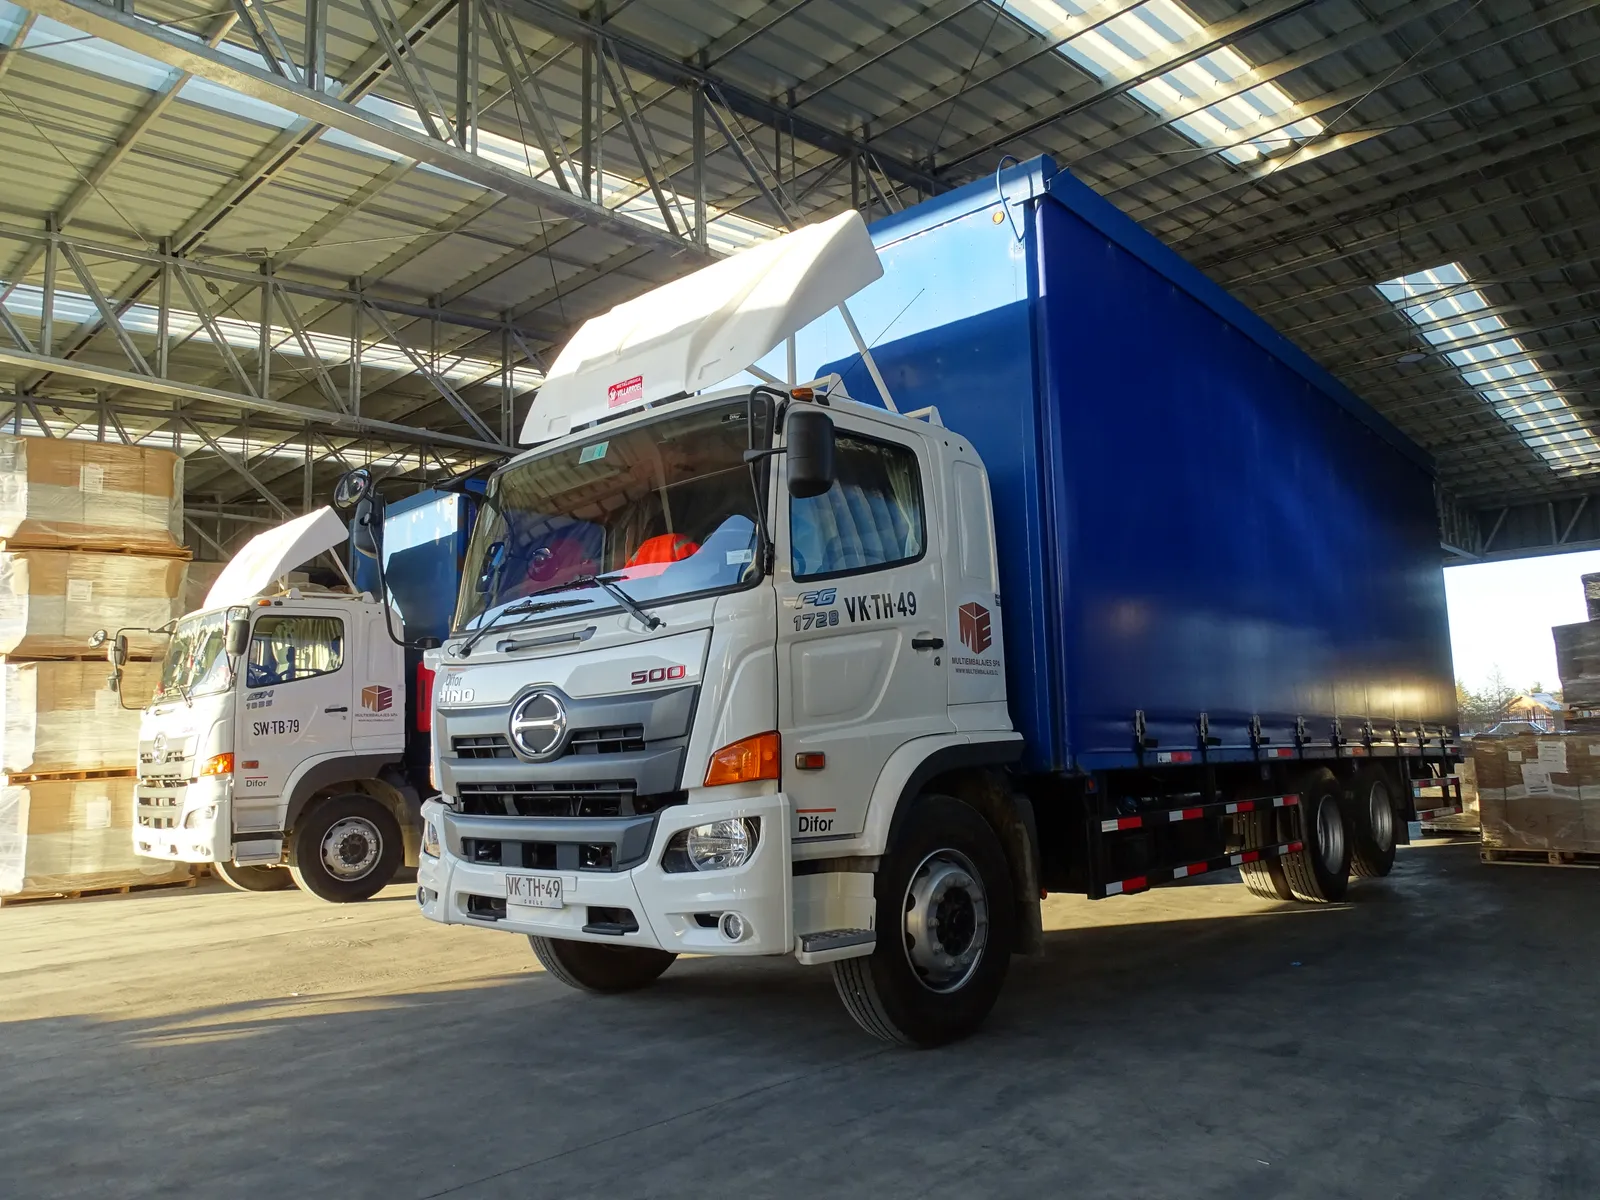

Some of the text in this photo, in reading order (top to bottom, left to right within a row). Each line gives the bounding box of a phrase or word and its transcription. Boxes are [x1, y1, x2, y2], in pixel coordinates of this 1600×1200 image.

[794, 588, 837, 609] FG
[793, 610, 839, 631] 1728
[952, 657, 992, 667] MULTIEMBALAJES
[631, 665, 686, 685] 500
[439, 688, 475, 702] HINO
[245, 779, 267, 787] Difor
[798, 816, 834, 832] Difor
